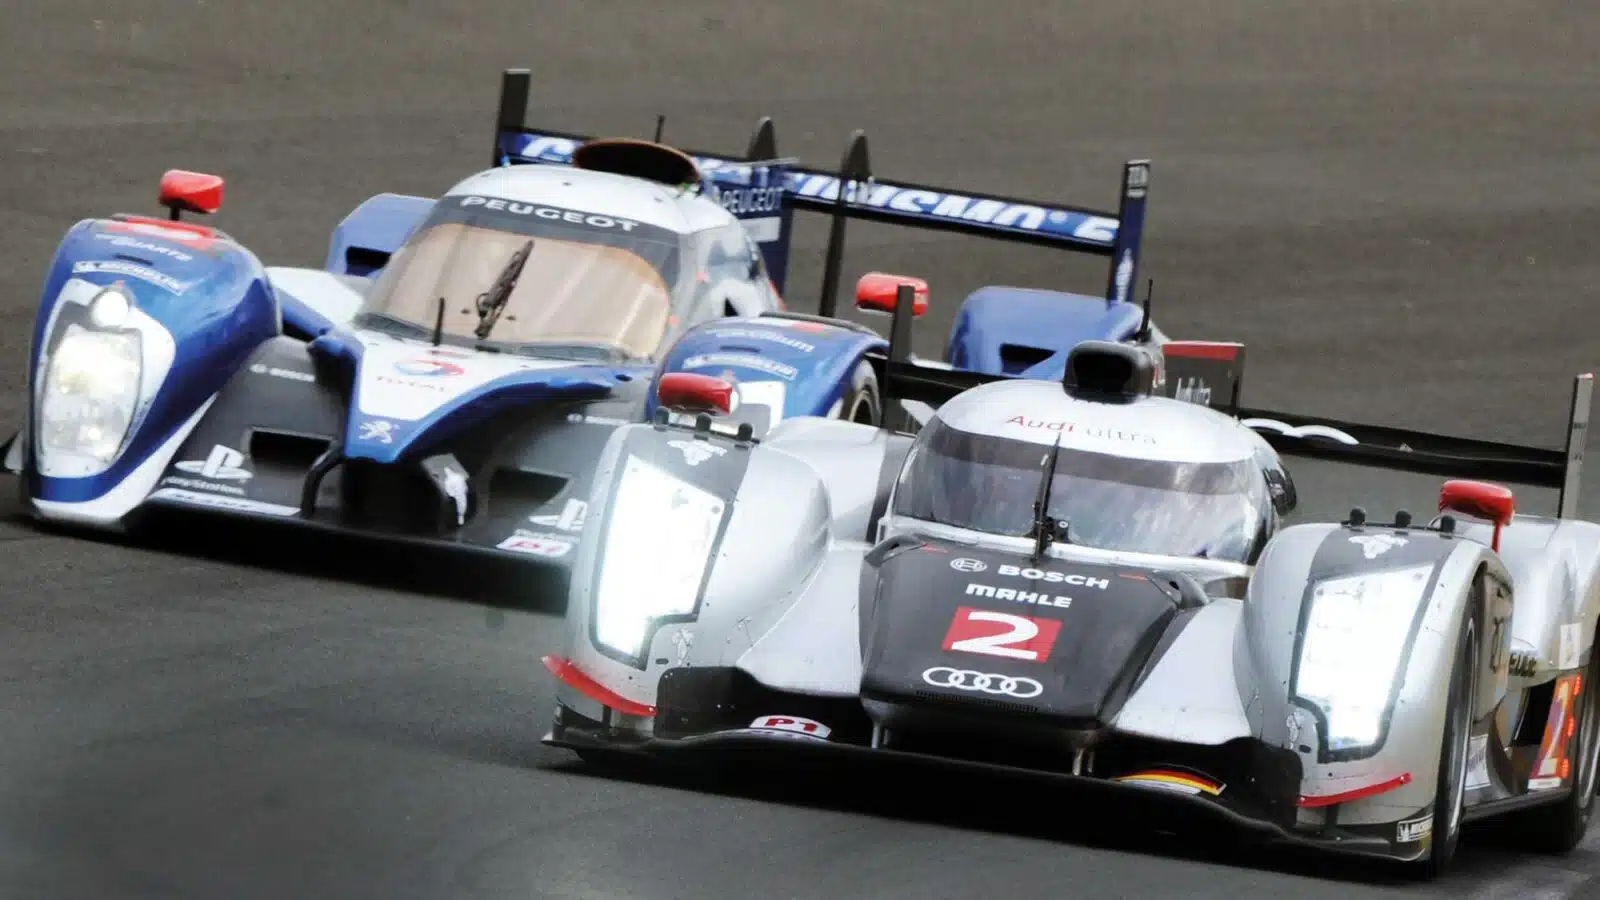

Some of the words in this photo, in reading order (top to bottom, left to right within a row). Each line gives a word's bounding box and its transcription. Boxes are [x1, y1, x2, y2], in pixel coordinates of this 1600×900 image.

[460, 196, 639, 232] PEUGEOT
[1005, 415, 1076, 432] Audi
[1086, 428, 1156, 445] ultra
[997, 564, 1109, 590] BOSCH
[966, 583, 1072, 609] MAHLE
[951, 611, 1039, 661] 2
[764, 717, 818, 733] P1
